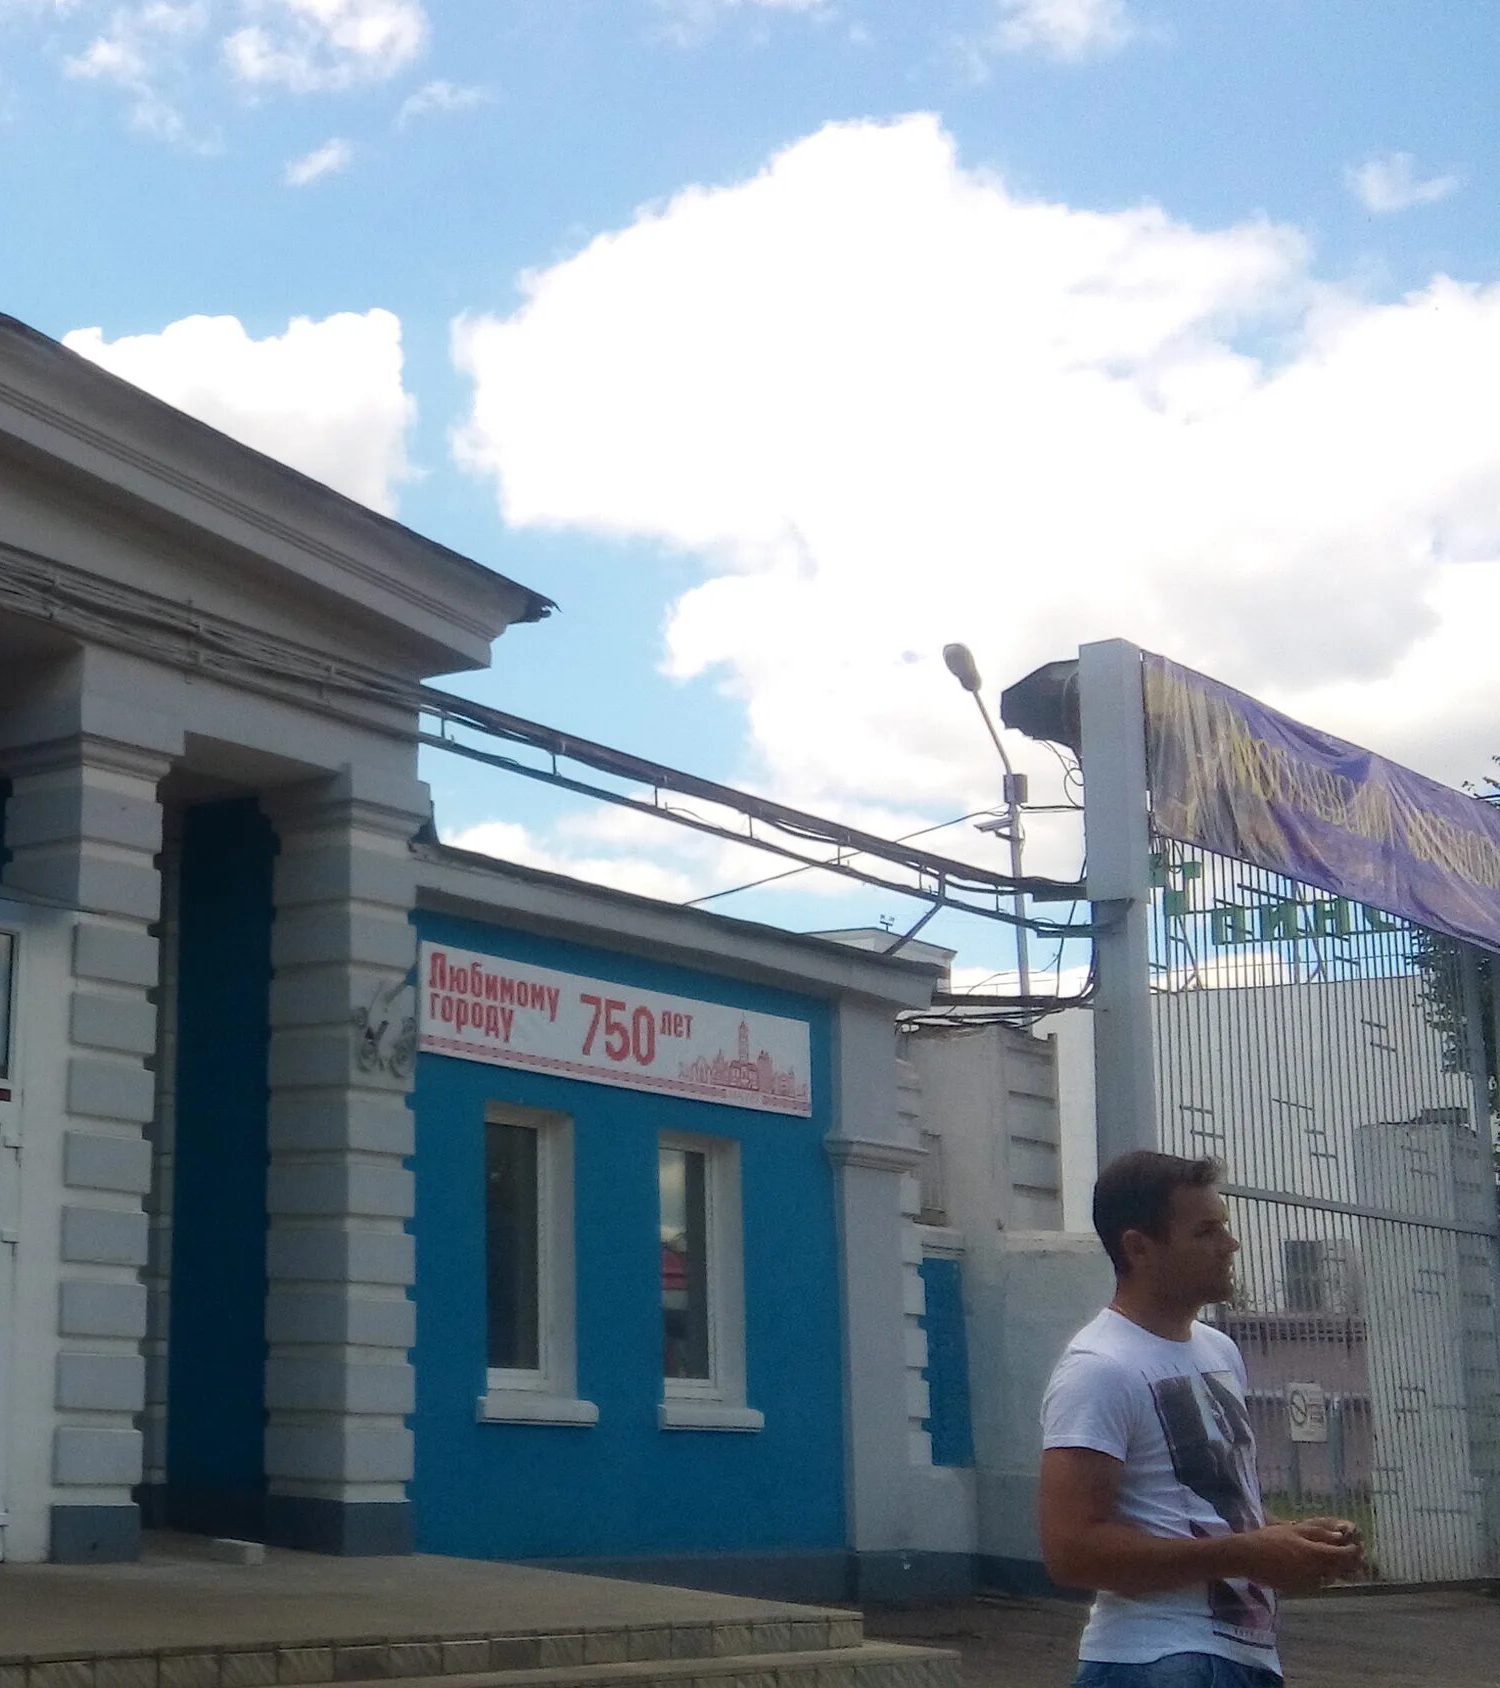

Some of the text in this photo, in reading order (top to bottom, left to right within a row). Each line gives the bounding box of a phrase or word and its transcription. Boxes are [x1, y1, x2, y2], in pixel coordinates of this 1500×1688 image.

[429, 952, 560, 1022] Любимому
[429, 992, 514, 1043] городу
[580, 994, 693, 1066] 750 лет
